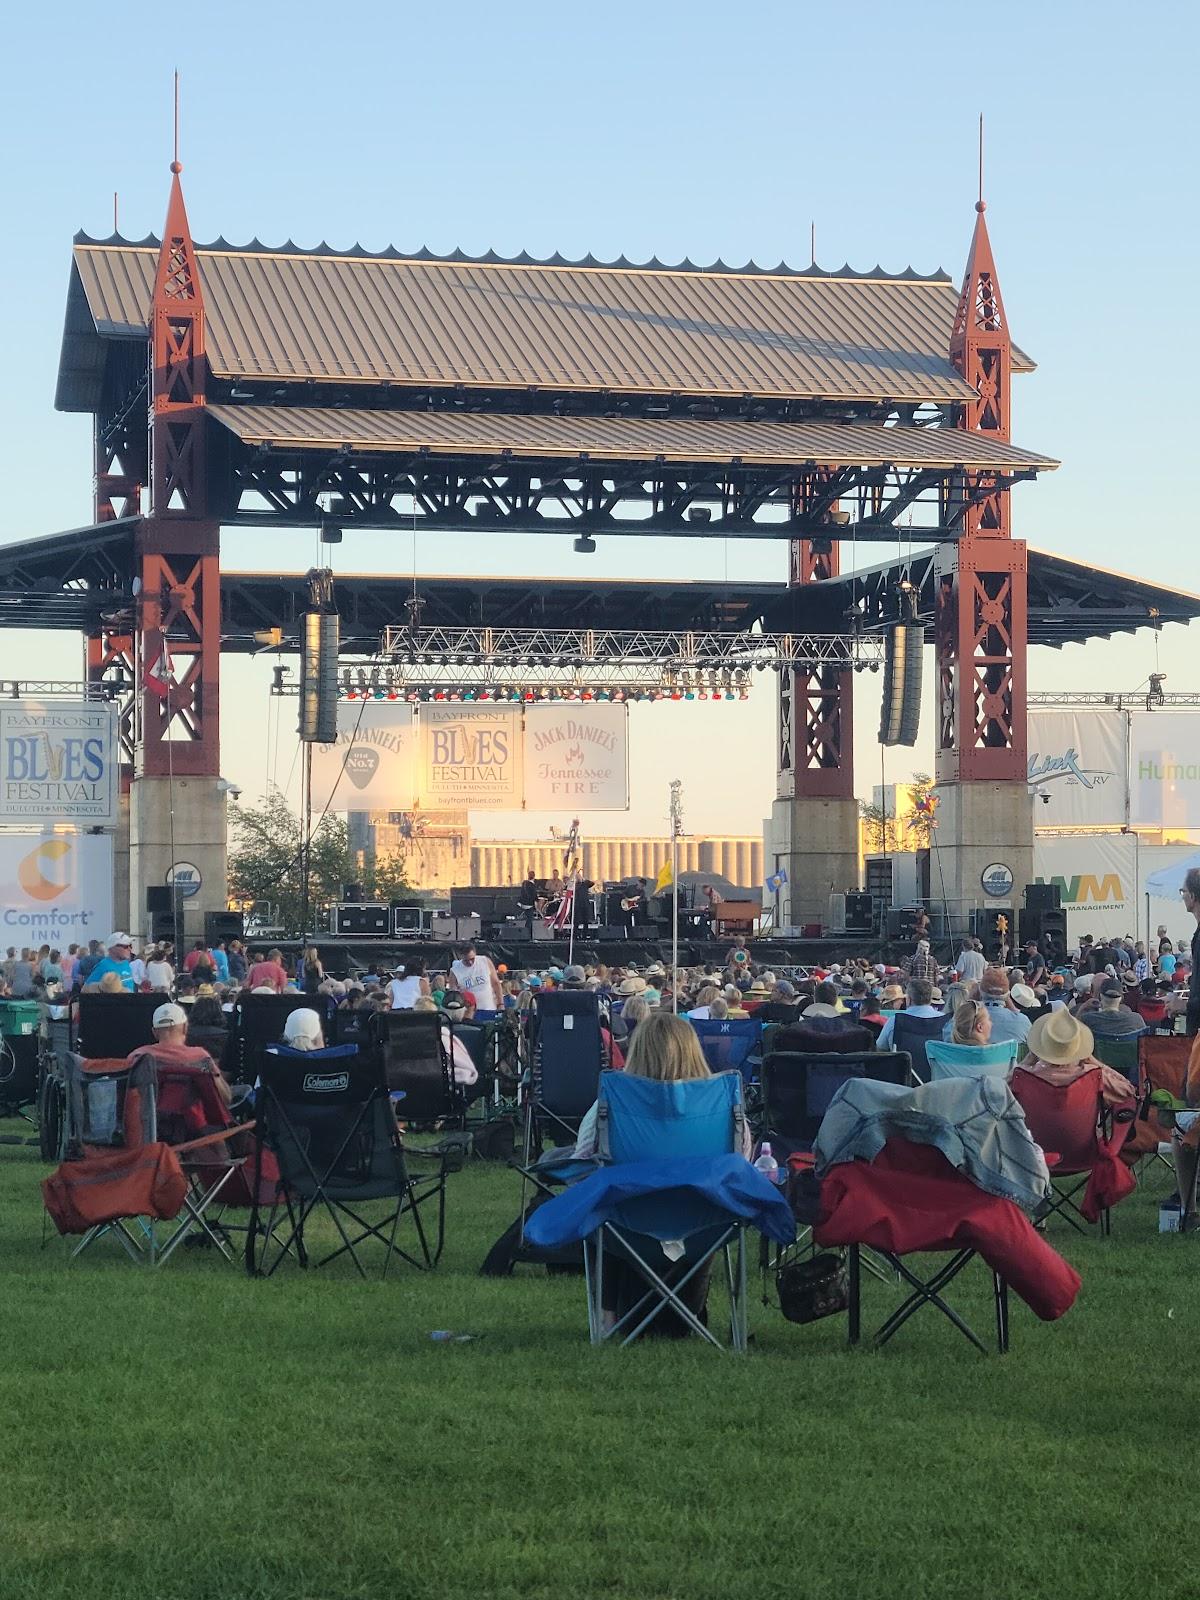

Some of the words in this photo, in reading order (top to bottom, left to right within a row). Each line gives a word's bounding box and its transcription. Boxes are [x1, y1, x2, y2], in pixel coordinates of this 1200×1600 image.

[7, 716, 104, 726] BAYFRONT
[432, 712, 507, 721] BAYFRONT
[534, 730, 566, 751] JACK
[567, 720, 618, 752] DANIEL'S
[431, 729, 508, 765] BLUES
[5, 735, 104, 782] BLUES
[432, 766, 508, 781] FESTIVAL
[538, 763, 612, 779] Tennessee
[1027, 748, 1094, 789] Link
[1093, 776, 1109, 785] RV
[6, 782, 104, 801] FESTIVAL
[552, 782, 600, 794] FIRE
[1068, 904, 1124, 912] MANAGEMENT
[32, 930, 60, 941] INN
[307, 1076, 339, 1088] Coleman
